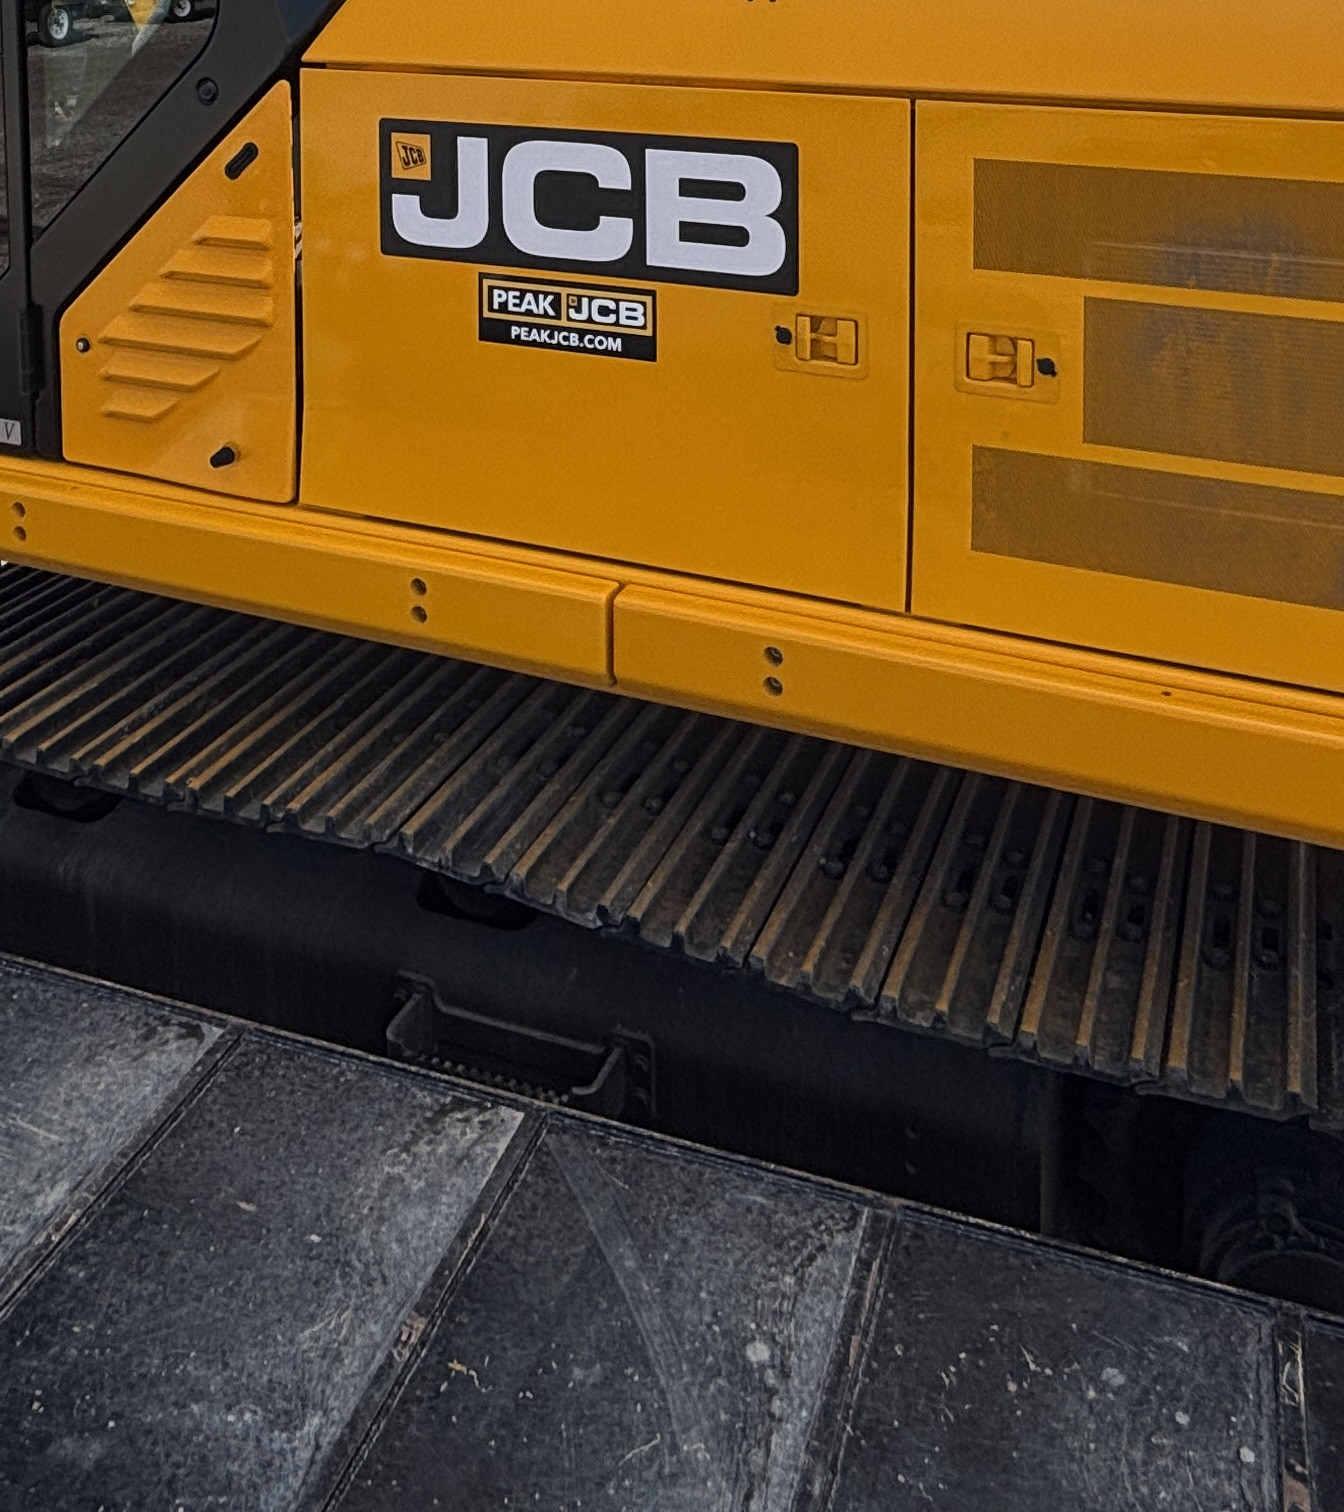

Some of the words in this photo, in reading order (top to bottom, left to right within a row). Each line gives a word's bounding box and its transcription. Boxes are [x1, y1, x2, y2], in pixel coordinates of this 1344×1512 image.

[401, 144, 425, 167] JCB
[391, 135, 786, 276] JCB
[492, 289, 556, 317] PEAK
[568, 297, 645, 327] JCB
[511, 325, 622, 352] PEAKJCB.COM
